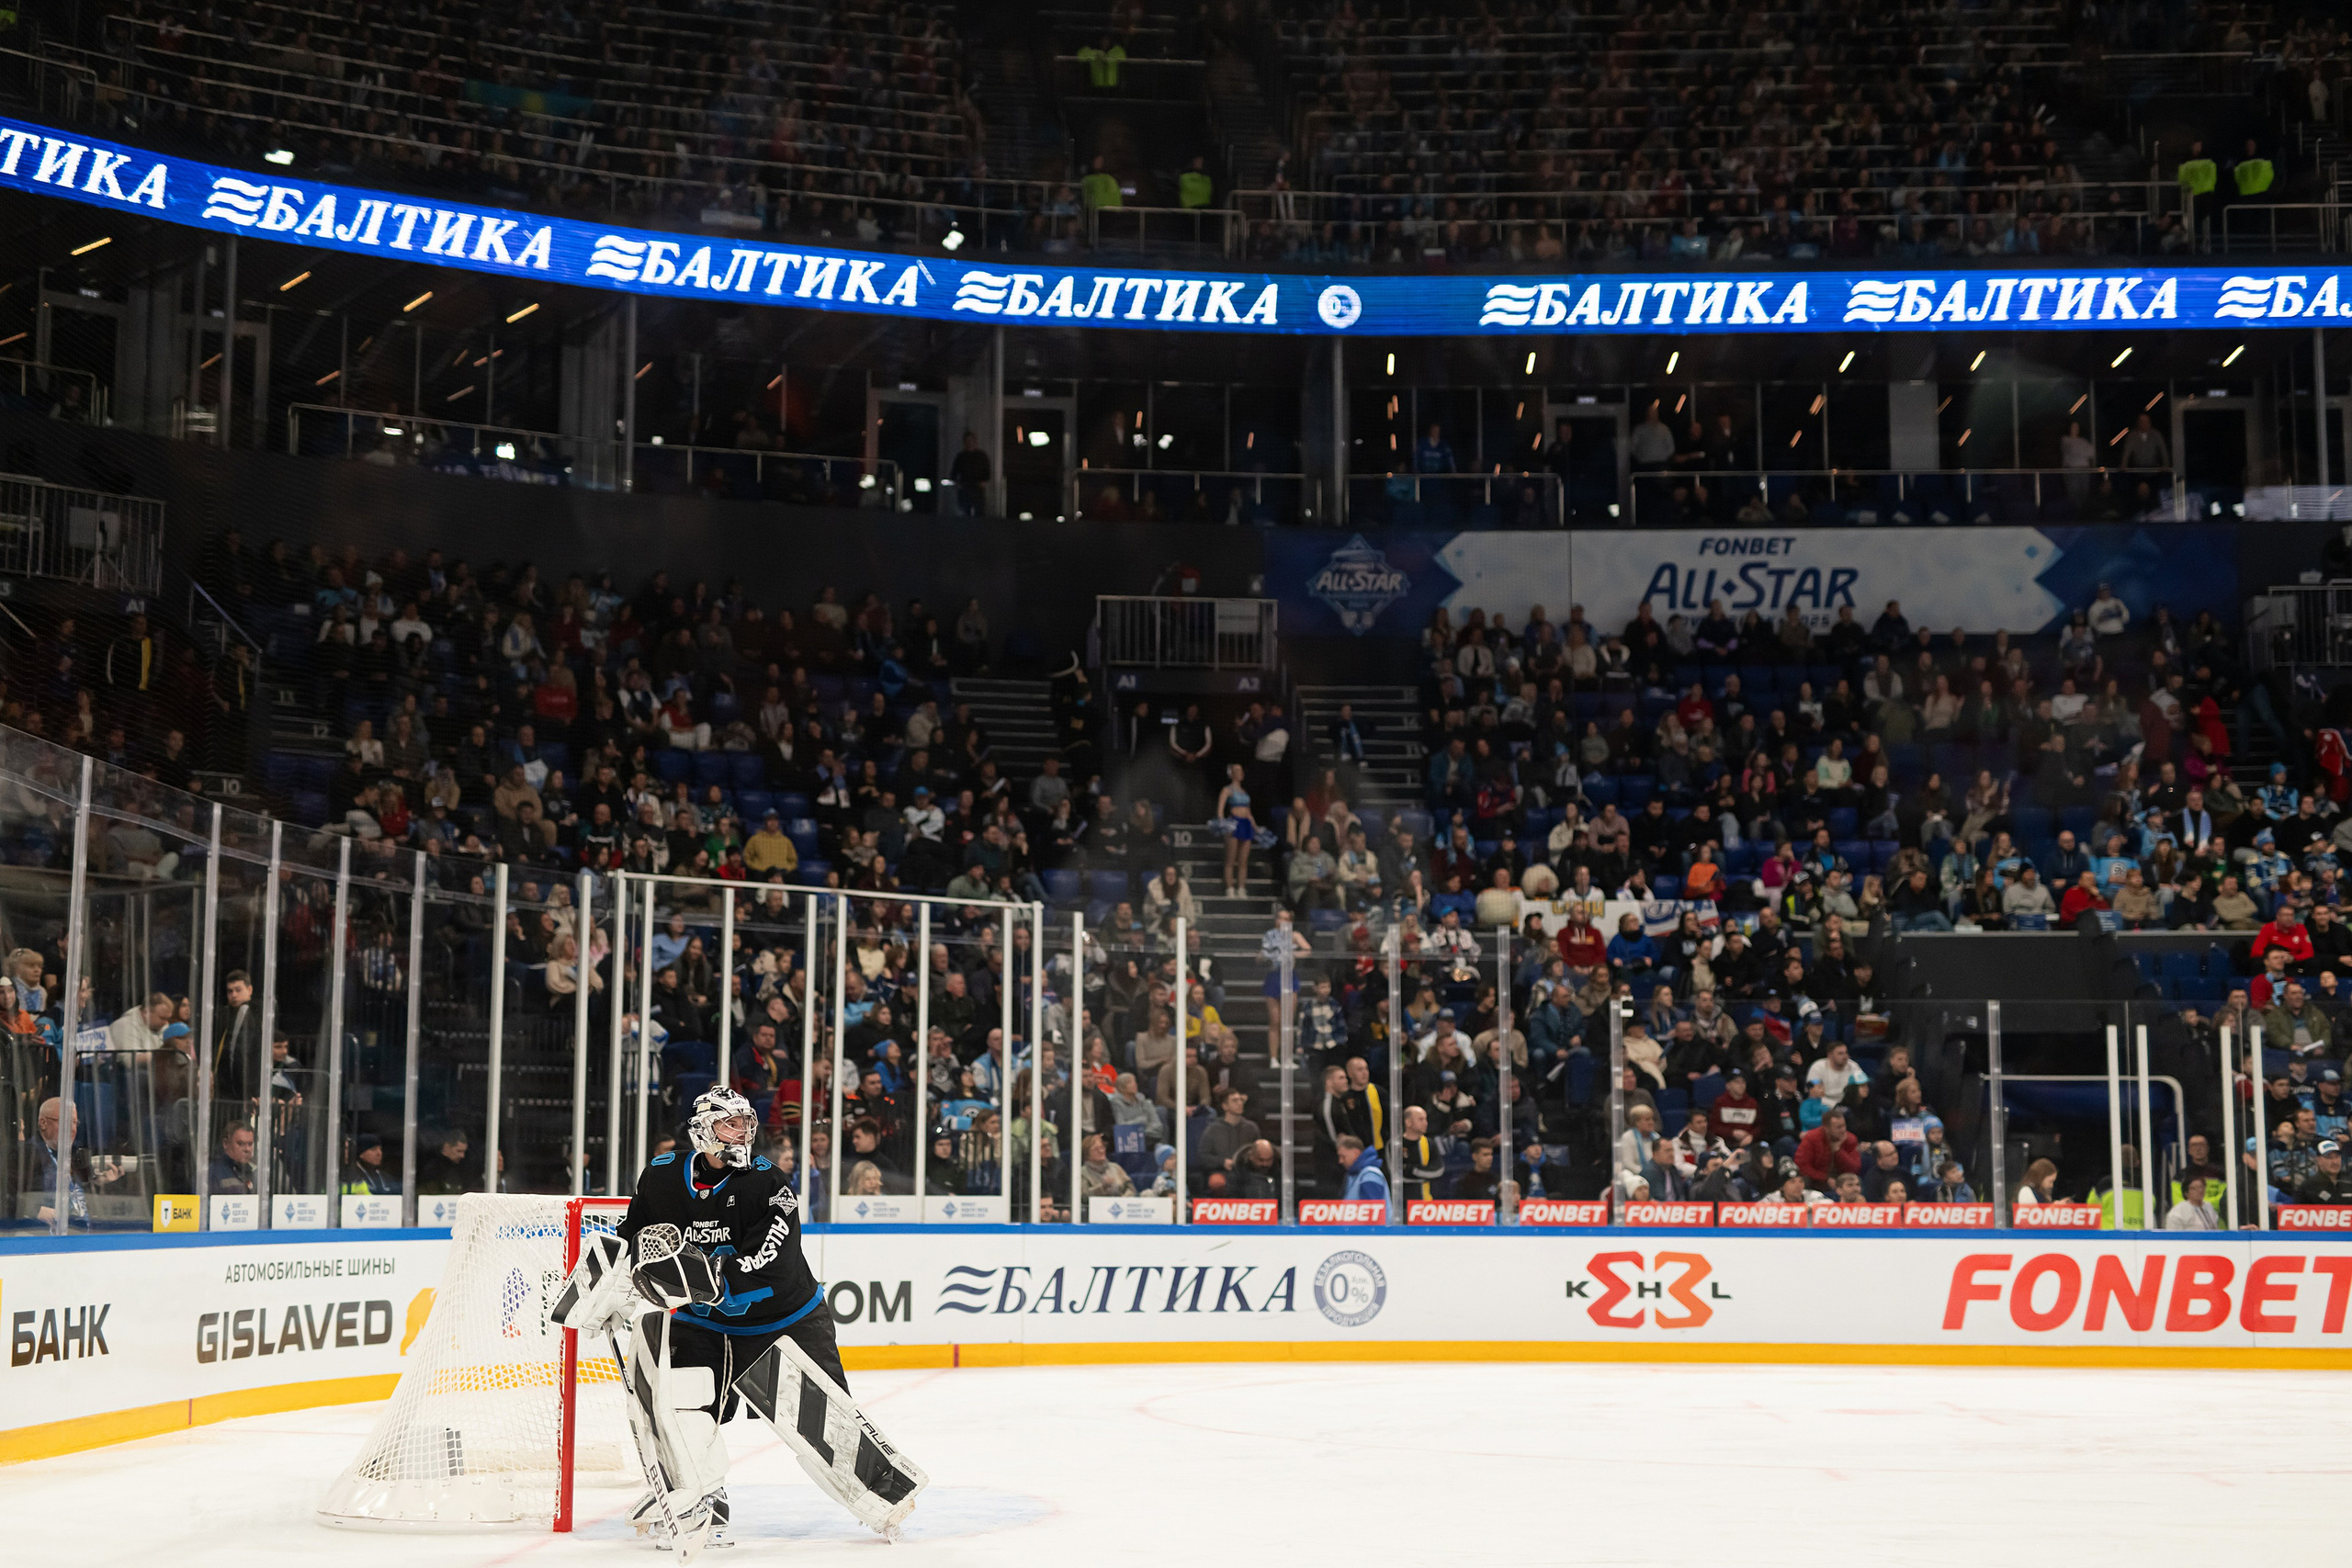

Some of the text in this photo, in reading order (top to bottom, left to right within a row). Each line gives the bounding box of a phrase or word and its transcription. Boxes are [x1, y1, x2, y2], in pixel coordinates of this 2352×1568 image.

[261, 185, 552, 270] БАЛТИКА
[632, 240, 919, 307] БАЛТИКА
[998, 274, 1278, 325] БАЛТИКА
[1529, 281, 1808, 325] БАЛТИКА
[1894, 276, 2177, 322] БАЛТИКА
[2267, 275, 2352, 318] БА
[1699, 536, 1796, 555] FONBET
[221, 778, 241, 795] 10
[1173, 830, 1193, 848] 10
[173, 1208, 192, 1220] БАНК
[1195, 1202, 1276, 1221] FONBET
[1300, 1203, 1383, 1222] FONBET
[1408, 1203, 1493, 1222] FONBET
[1520, 1204, 1606, 1223] FONBET
[1625, 1205, 1711, 1224] FONBET
[1720, 1205, 1806, 1224] FONBET
[1813, 1206, 1899, 1224] FONBET
[1905, 1206, 1993, 1224] FONBET
[2015, 1207, 2099, 1225] FONBET
[692, 1220, 719, 1229] FONBET
[225, 1258, 395, 1283] АВТОМОБИЛЬНЫЕ ШИНЫ
[991, 1266, 1296, 1314] БАЛТИКА
[1942, 1253, 2352, 1334] FONBET
[11, 1303, 111, 1368] БАНК
[197, 1300, 393, 1364] GISLAVED
[855, 1409, 896, 1456] TRUE
